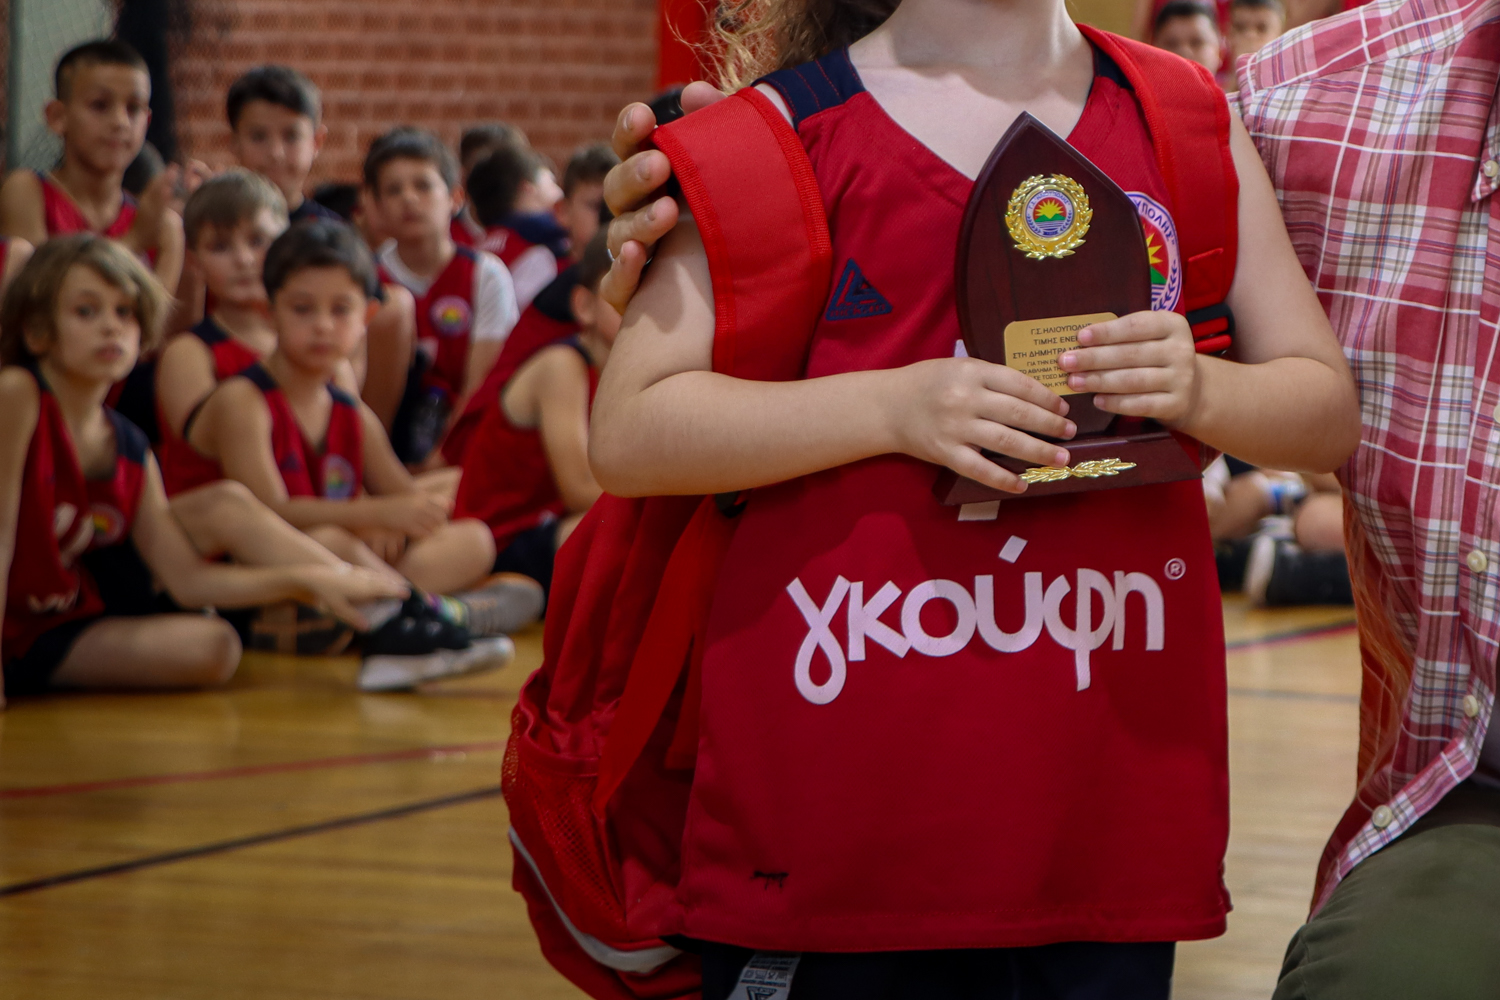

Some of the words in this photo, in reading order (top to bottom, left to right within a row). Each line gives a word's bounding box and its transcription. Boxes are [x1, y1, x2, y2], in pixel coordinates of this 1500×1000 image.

[1033, 337, 1058, 346] ΤΙΜΗΣ
[1060, 335, 1079, 343] ΕΝΕ
[1012, 352, 1027, 360] ΣΤΗ
[1029, 347, 1067, 358] ΔΗΜΗΤΡΑ
